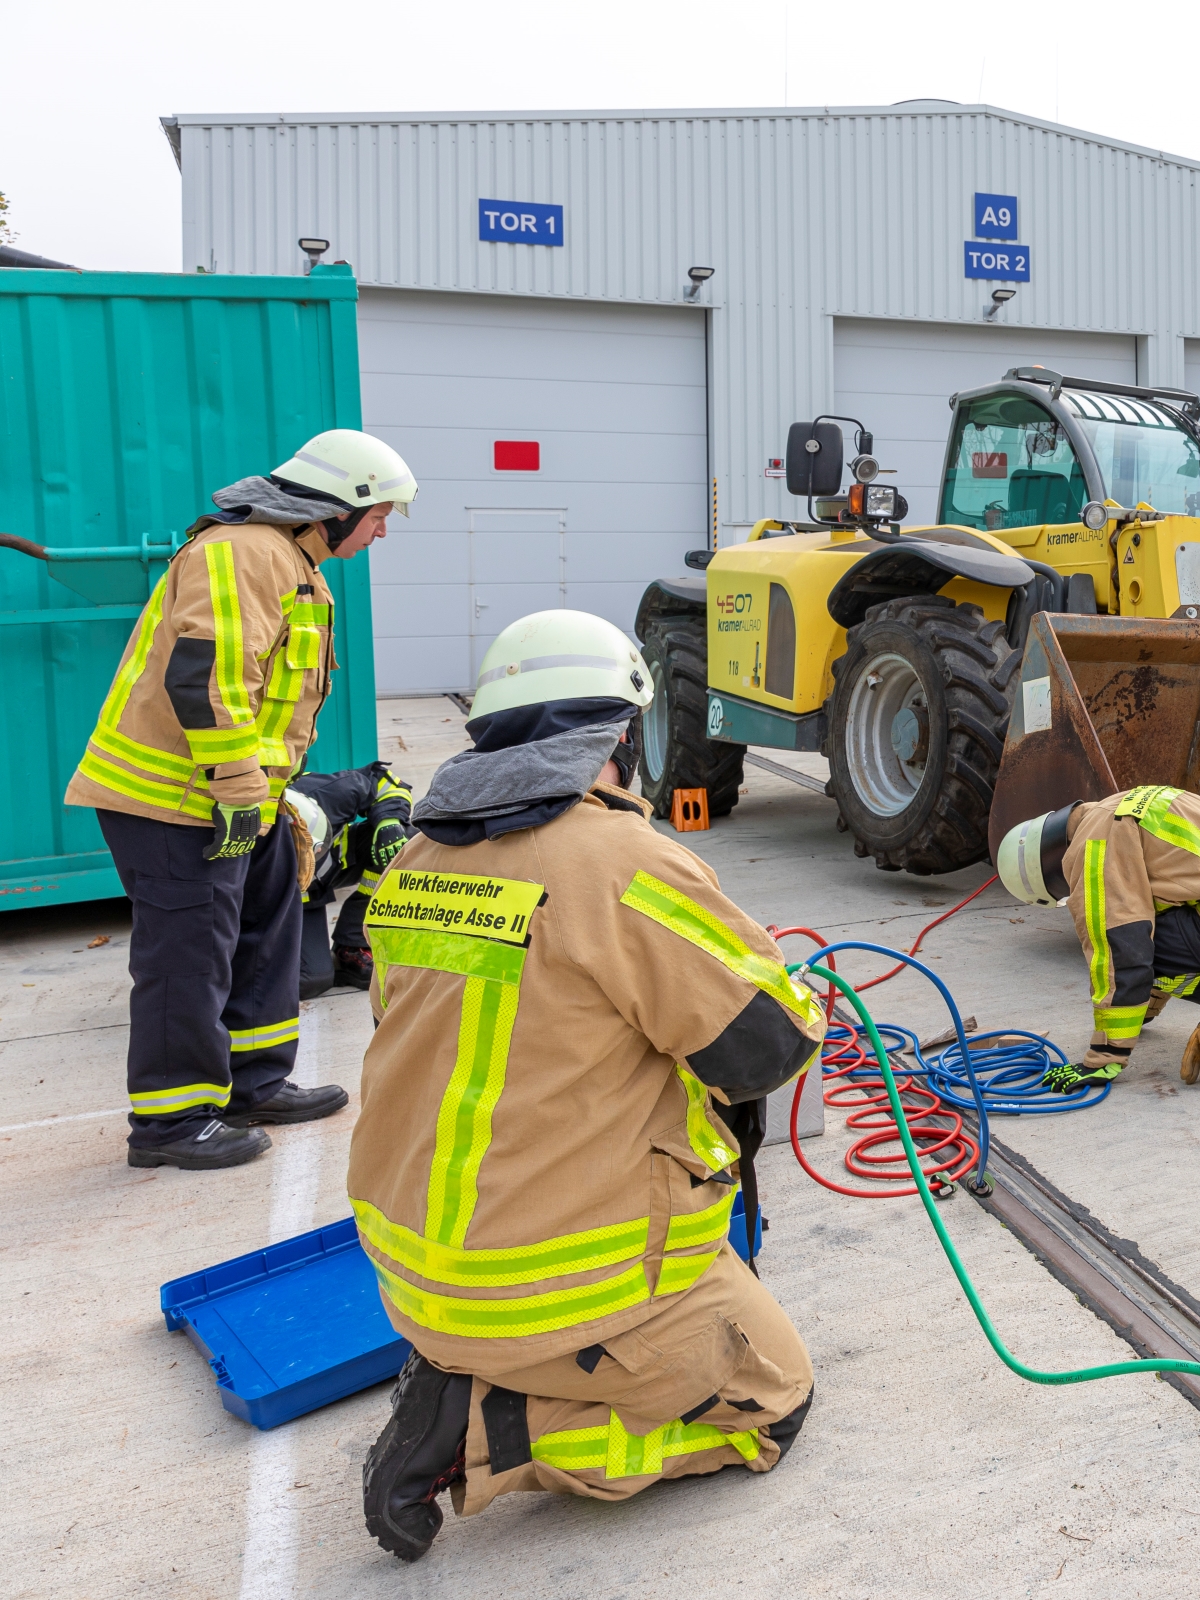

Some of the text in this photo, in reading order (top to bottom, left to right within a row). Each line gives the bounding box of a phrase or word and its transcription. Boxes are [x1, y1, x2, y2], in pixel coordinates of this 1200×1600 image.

[484, 210, 555, 234] TOR 1
[980, 206, 1011, 227] A9
[968, 251, 1026, 272] TOR 2
[716, 593, 753, 614] 4507
[728, 660, 739, 676] 118
[711, 705, 721, 729] 20
[398, 873, 504, 898] Werkfeuerwehr
[369, 898, 526, 933] Schachtanlage Asse II
